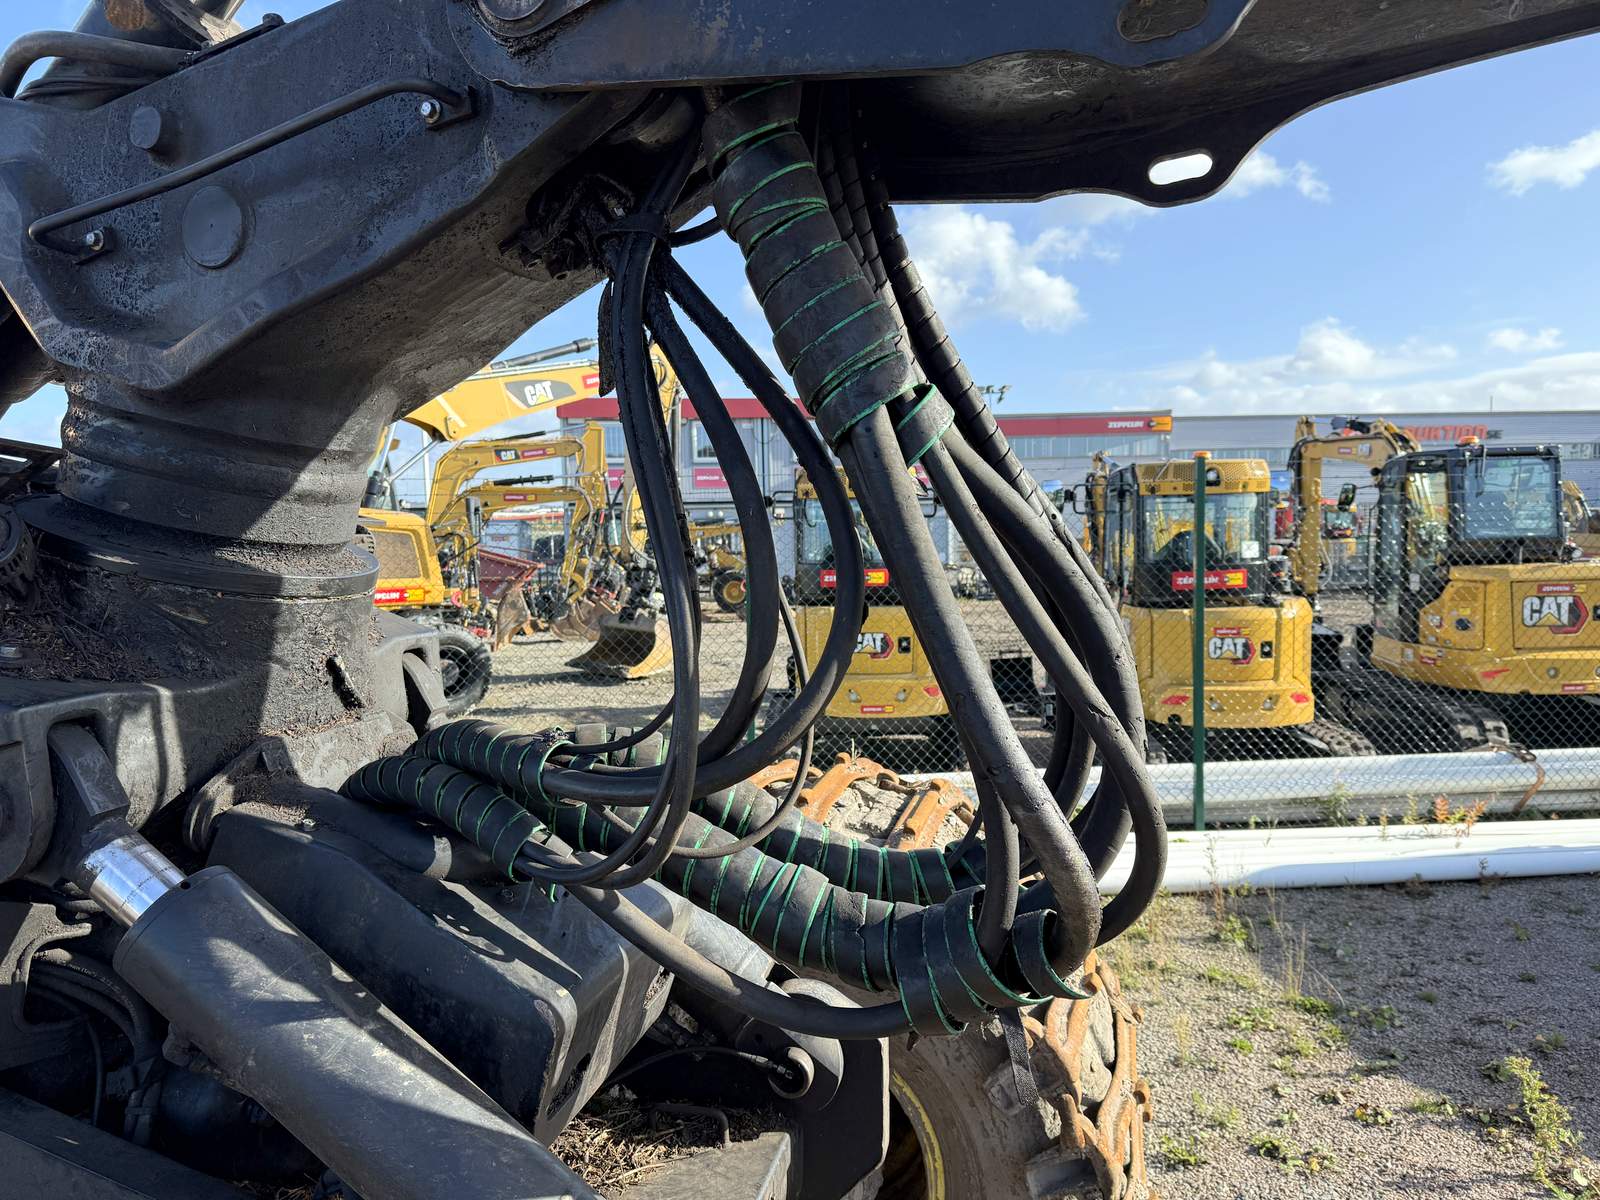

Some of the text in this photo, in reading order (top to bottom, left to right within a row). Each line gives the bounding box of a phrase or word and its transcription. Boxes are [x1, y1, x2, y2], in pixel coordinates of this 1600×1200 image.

[524, 380, 554, 406] CAT
[501, 449, 516, 461] CAT
[1522, 595, 1574, 627] CAT
[1208, 637, 1247, 660] CAT
